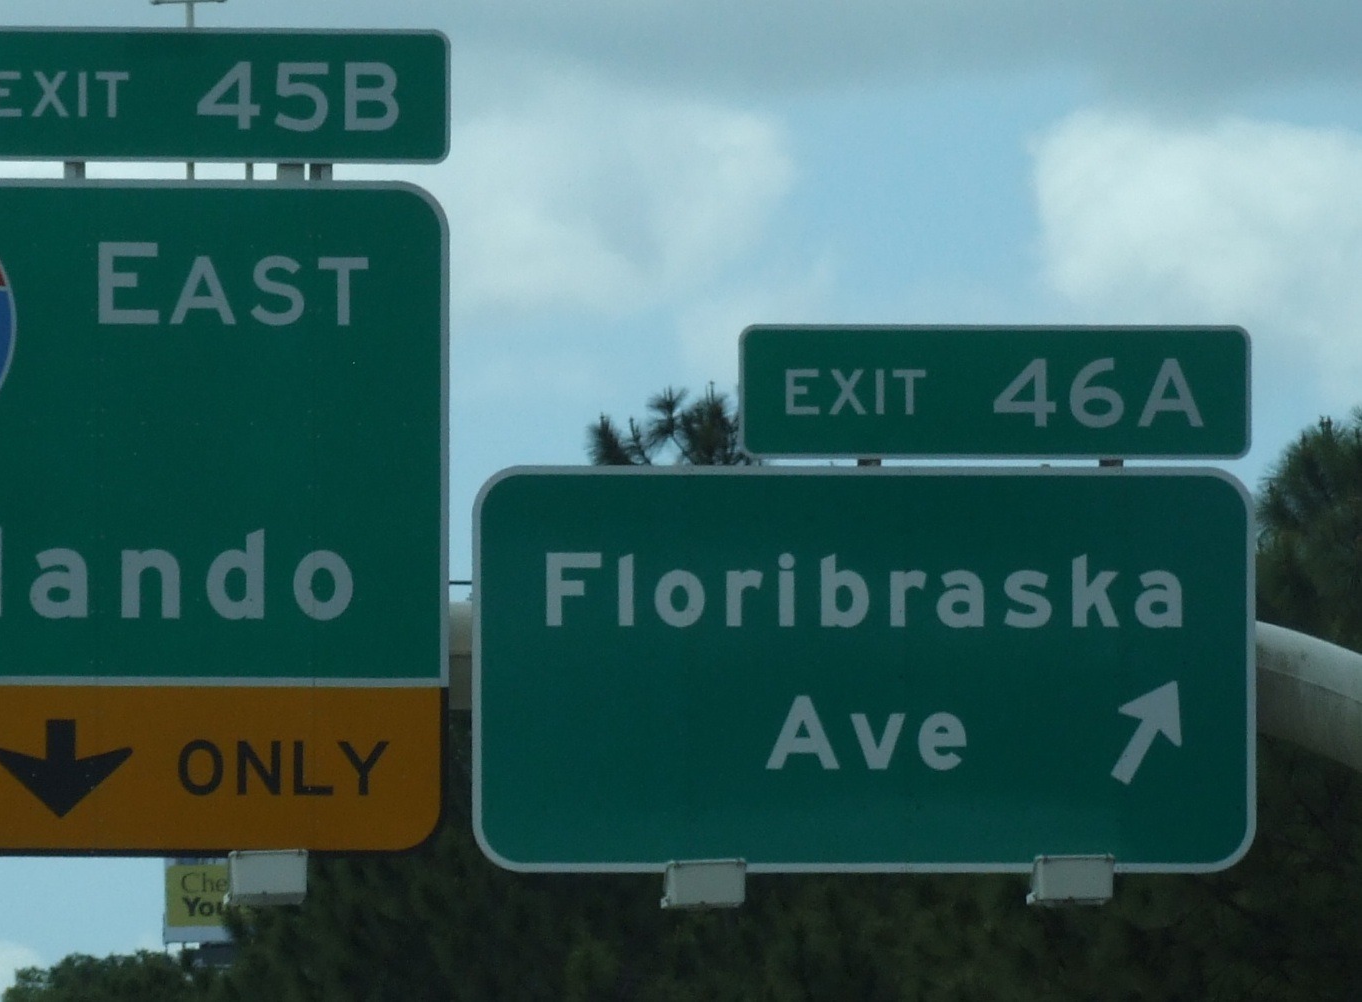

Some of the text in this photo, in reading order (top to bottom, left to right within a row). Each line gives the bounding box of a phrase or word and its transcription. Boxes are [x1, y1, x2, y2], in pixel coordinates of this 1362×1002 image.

[196, 60, 401, 133] 45B
[97, 241, 370, 326] EAST
[785, 357, 1205, 429] EXIT 46A
[544, 551, 1184, 629] Floribraska
[176, 738, 390, 797] ONLY
[765, 695, 968, 771] Ave
